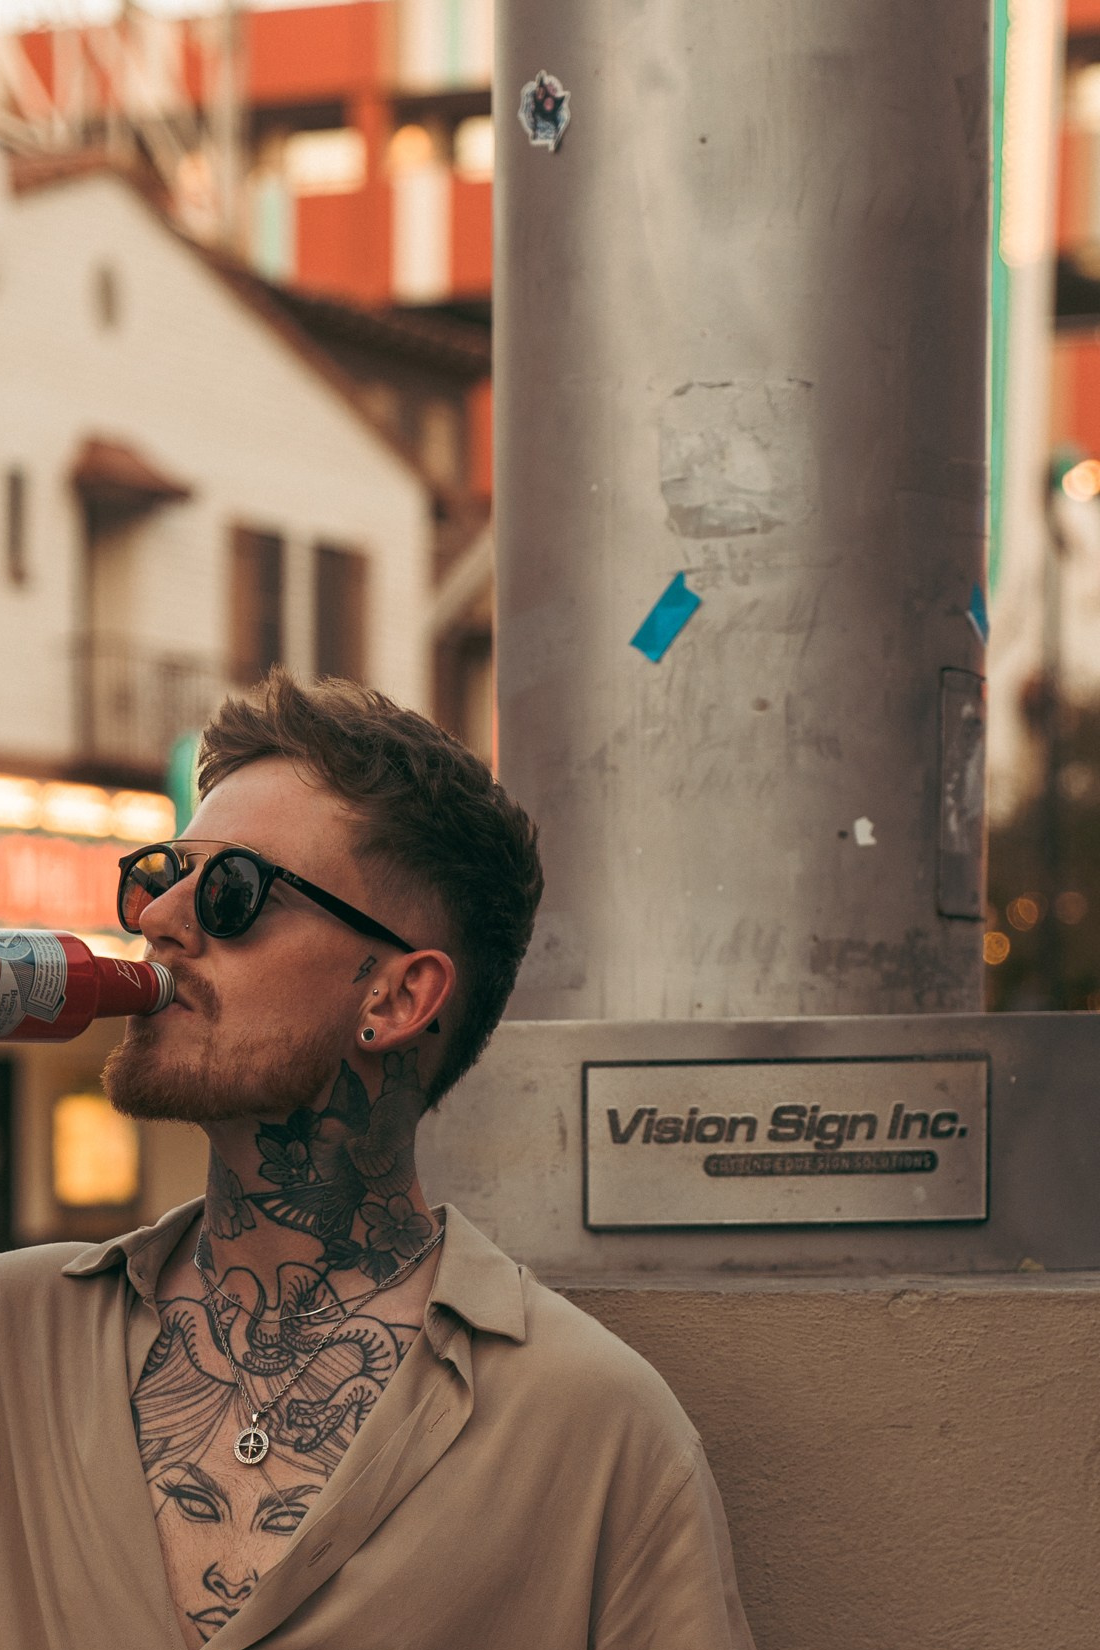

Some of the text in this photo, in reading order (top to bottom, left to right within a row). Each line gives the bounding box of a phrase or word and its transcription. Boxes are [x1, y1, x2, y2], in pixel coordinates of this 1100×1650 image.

[608, 1101, 968, 1150] Vision Sign Inc.
[816, 1154, 850, 1171] SIGN
[854, 1151, 932, 1170] SOLUTIONS
